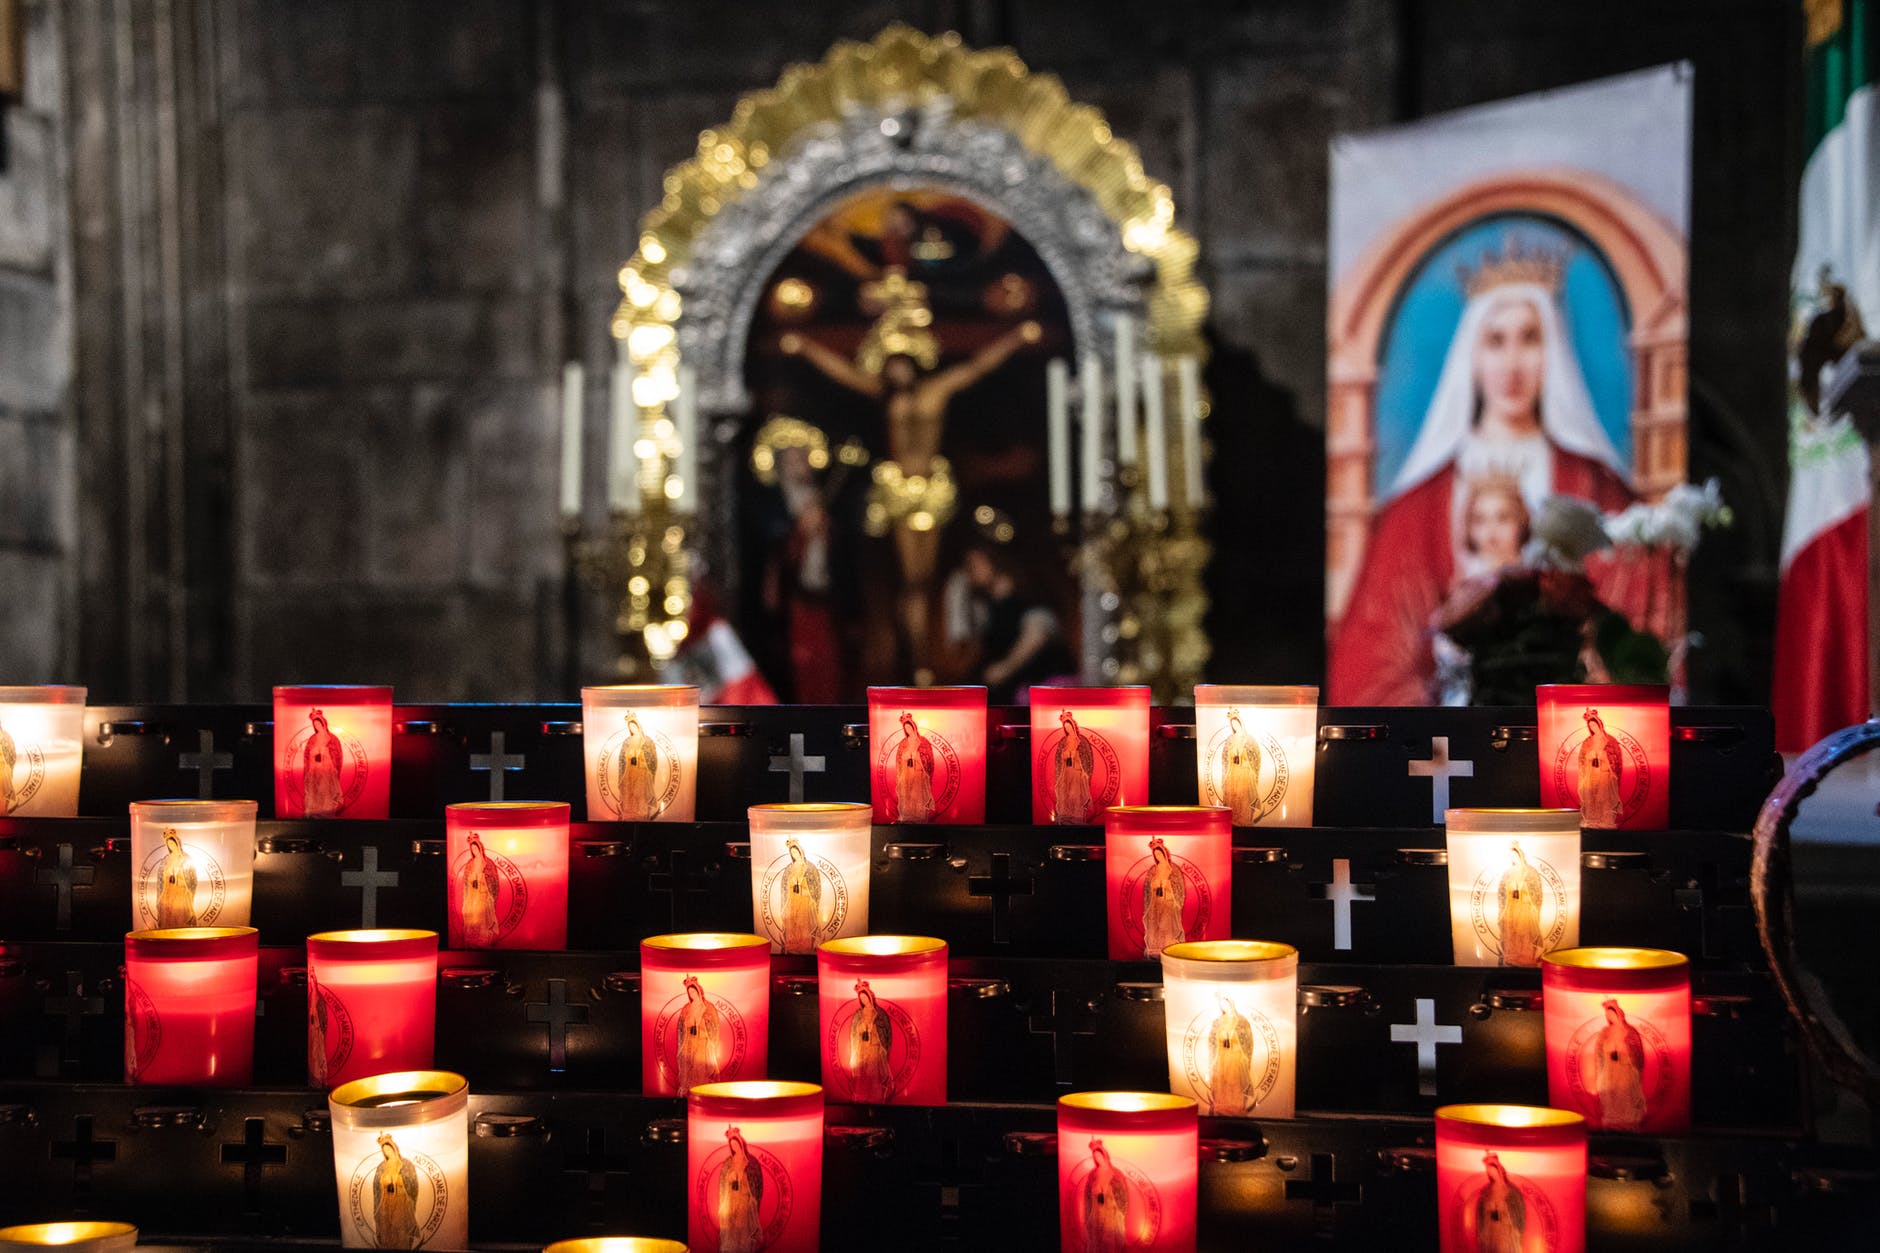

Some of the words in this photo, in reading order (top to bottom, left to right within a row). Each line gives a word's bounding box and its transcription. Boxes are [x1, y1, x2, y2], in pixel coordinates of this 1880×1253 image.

[1088, 734, 1111, 755] NOTRE
[1106, 755, 1118, 775] DAME
[671, 774, 679, 784] DE
[1109, 776, 1117, 787] DE
[1277, 775, 1286, 786] DE
[663, 784, 677, 804] PARIS
[1267, 785, 1284, 807] PARIS
[512, 877, 525, 898] DAME
[817, 860, 839, 880] NOTRE
[834, 880, 846, 901] DAME
[203, 902, 220, 923] PARIS
[339, 1014, 351, 1036] DAME
[715, 1000, 738, 1021] NOTRE
[733, 1020, 745, 1042] DAME
[1270, 1056, 1278, 1068] DE
[1261, 1068, 1276, 1092] PARIS
[432, 1173, 445, 1195] DAME
[351, 1174, 364, 1228] CATHEDRALE
[436, 1196, 445, 1206] DE
[427, 1207, 443, 1231] PARIS
